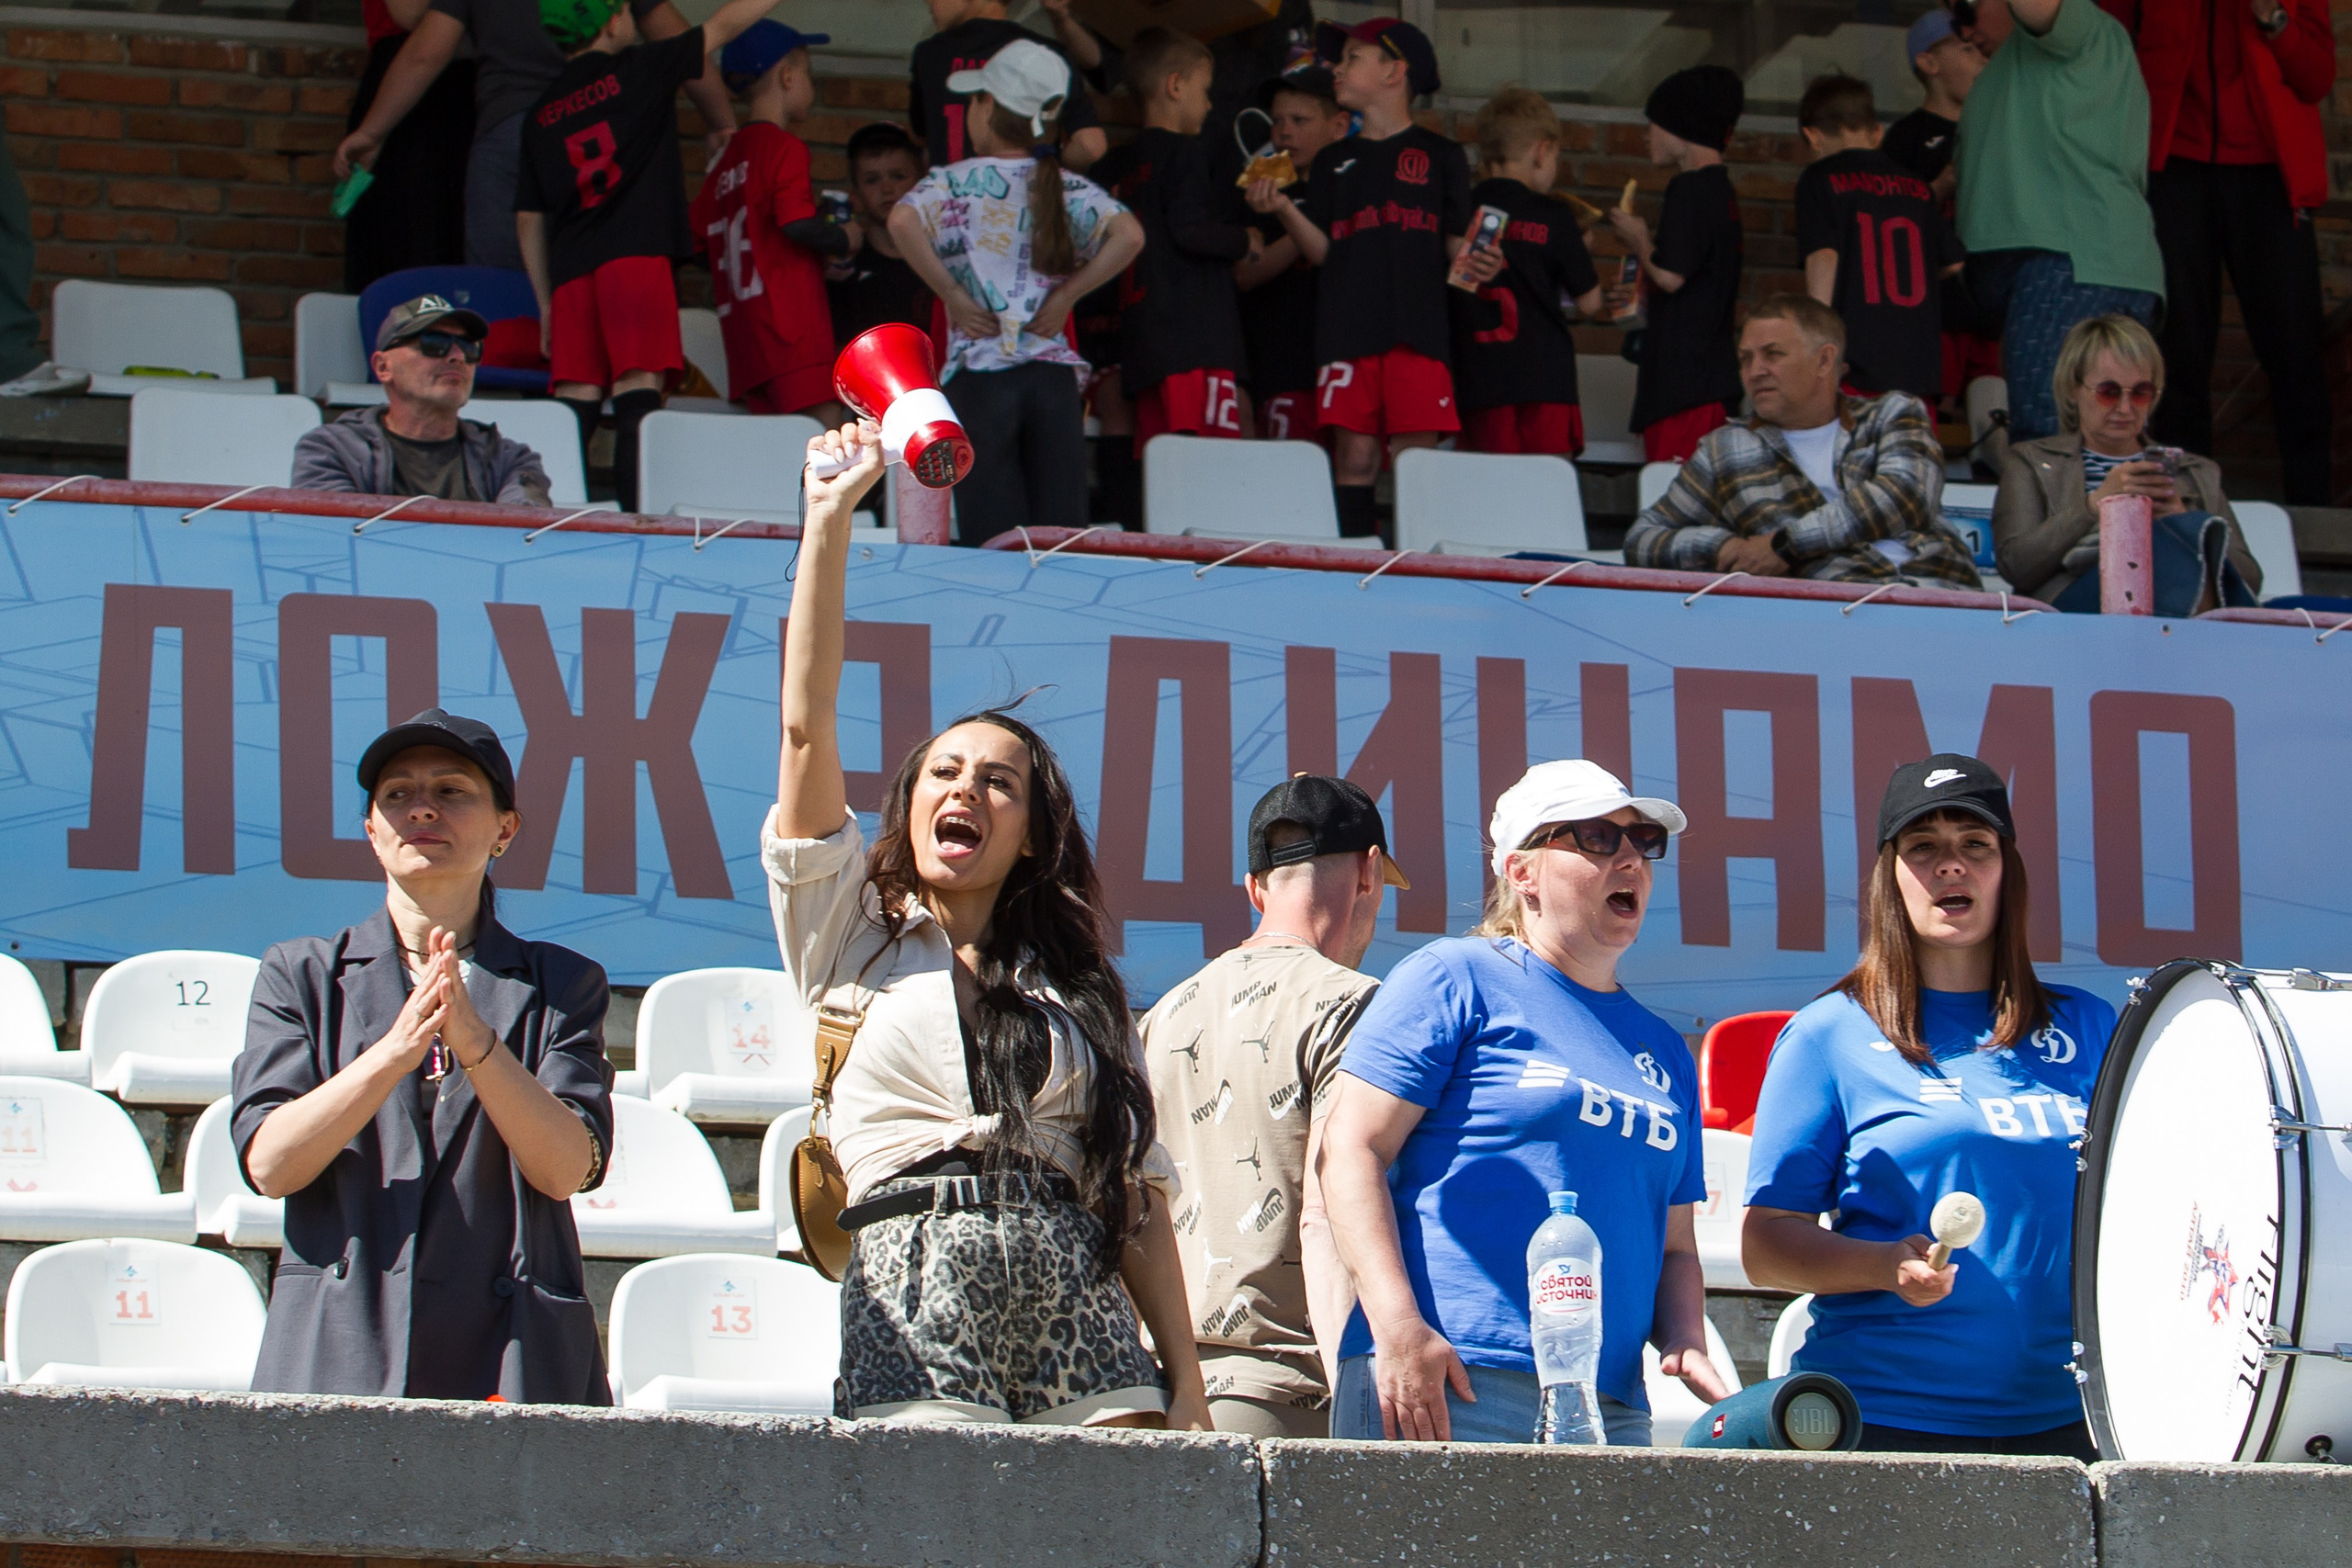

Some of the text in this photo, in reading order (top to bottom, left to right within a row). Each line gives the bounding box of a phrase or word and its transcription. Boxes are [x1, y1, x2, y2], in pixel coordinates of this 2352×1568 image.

[564, 120, 622, 209] 8
[1856, 211, 1928, 308] 10
[176, 980, 211, 1006] 12
[1249, 981, 1278, 1008] MAN
[1578, 1077, 1679, 1152] ВТБ
[1977, 1093, 2088, 1137] ВТБ
[1255, 1198, 1285, 1233] JUMP
[1693, 1190, 1722, 1215] 7
[116, 1291, 153, 1318] 11
[711, 1305, 752, 1333] 13
[1221, 1304, 1250, 1339] JUMP
[1792, 1408, 1837, 1435] JBL
